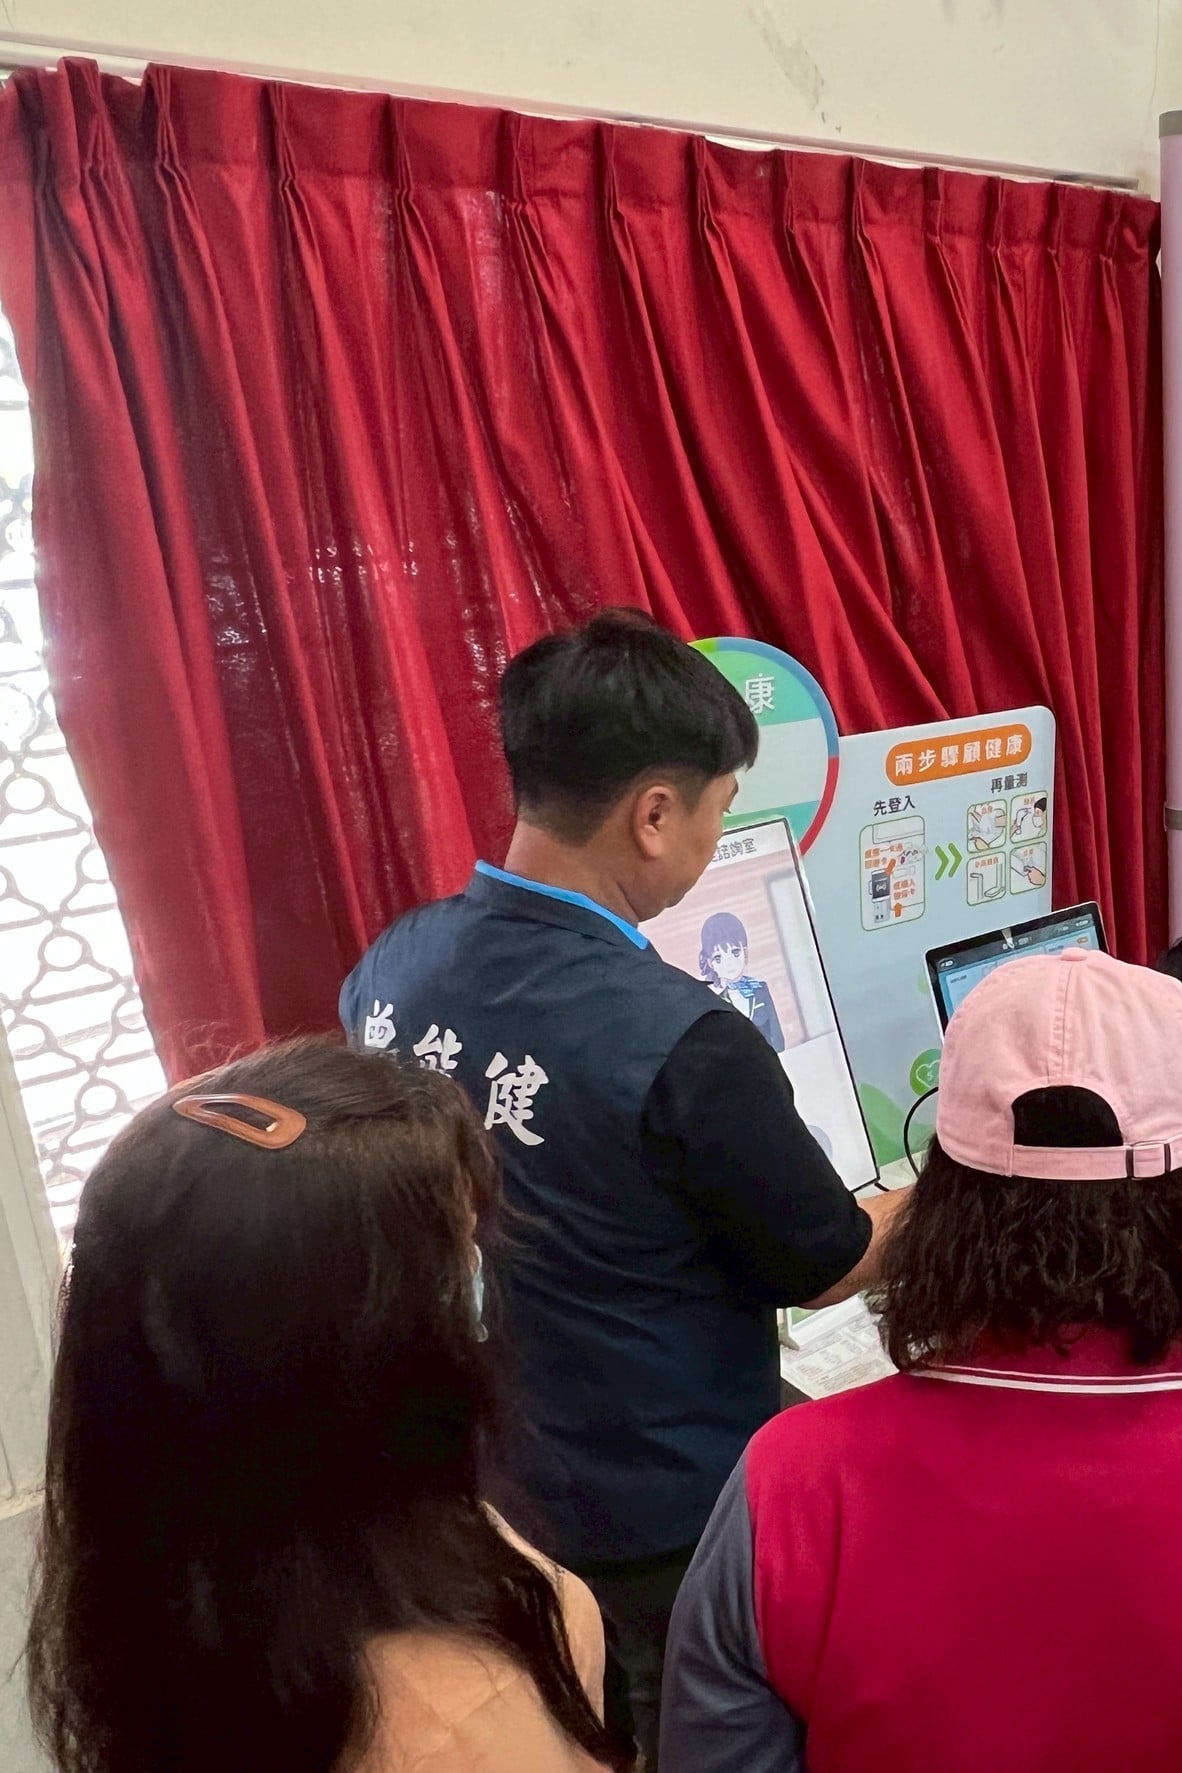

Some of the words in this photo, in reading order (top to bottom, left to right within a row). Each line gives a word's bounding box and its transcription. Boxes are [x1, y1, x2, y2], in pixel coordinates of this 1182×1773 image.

[744, 673, 776, 715] 康
[895, 734, 1023, 776] 兩步驟顧健康
[990, 772, 1028, 793] 再量測
[873, 795, 916, 817] 先登入
[711, 837, 757, 862] 諮詢室
